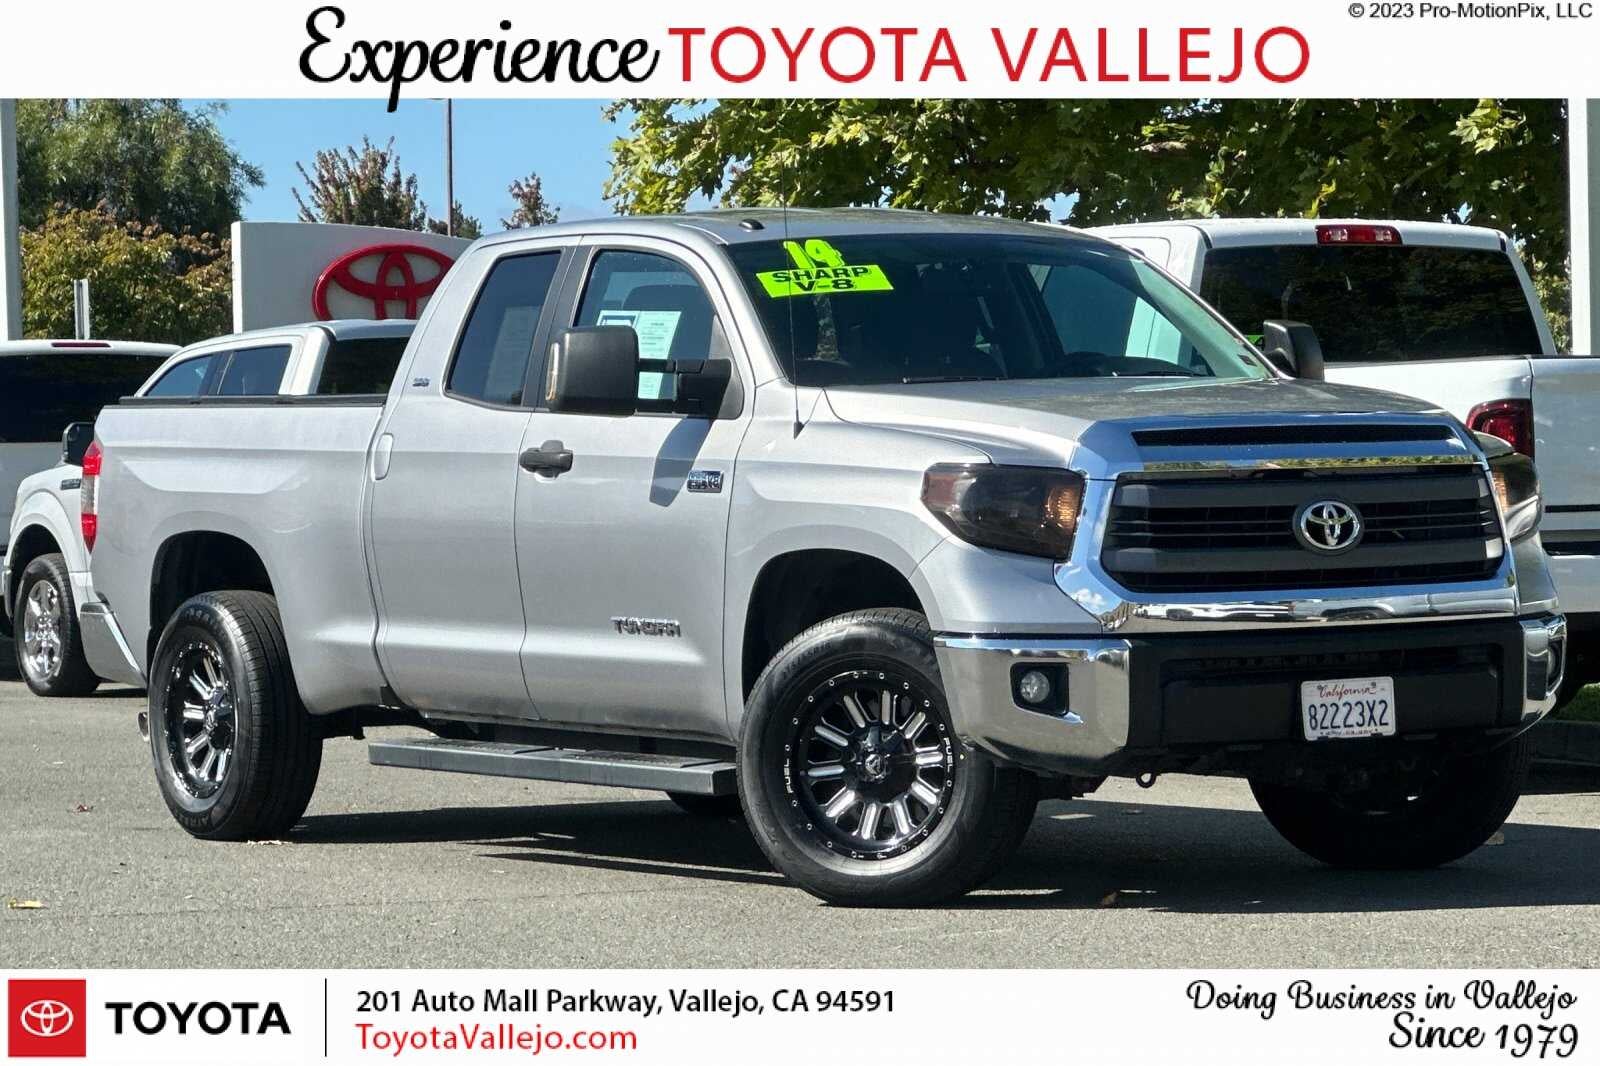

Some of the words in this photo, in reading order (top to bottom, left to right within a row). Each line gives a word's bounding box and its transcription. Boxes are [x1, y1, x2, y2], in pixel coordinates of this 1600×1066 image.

[772, 266, 869, 283] SHARP
[794, 278, 855, 292] V-8
[1318, 683, 1377, 701] California
[1308, 699, 1390, 731] 82223X2
[943, 736, 955, 773] FUEL
[783, 757, 795, 795] FUEL
